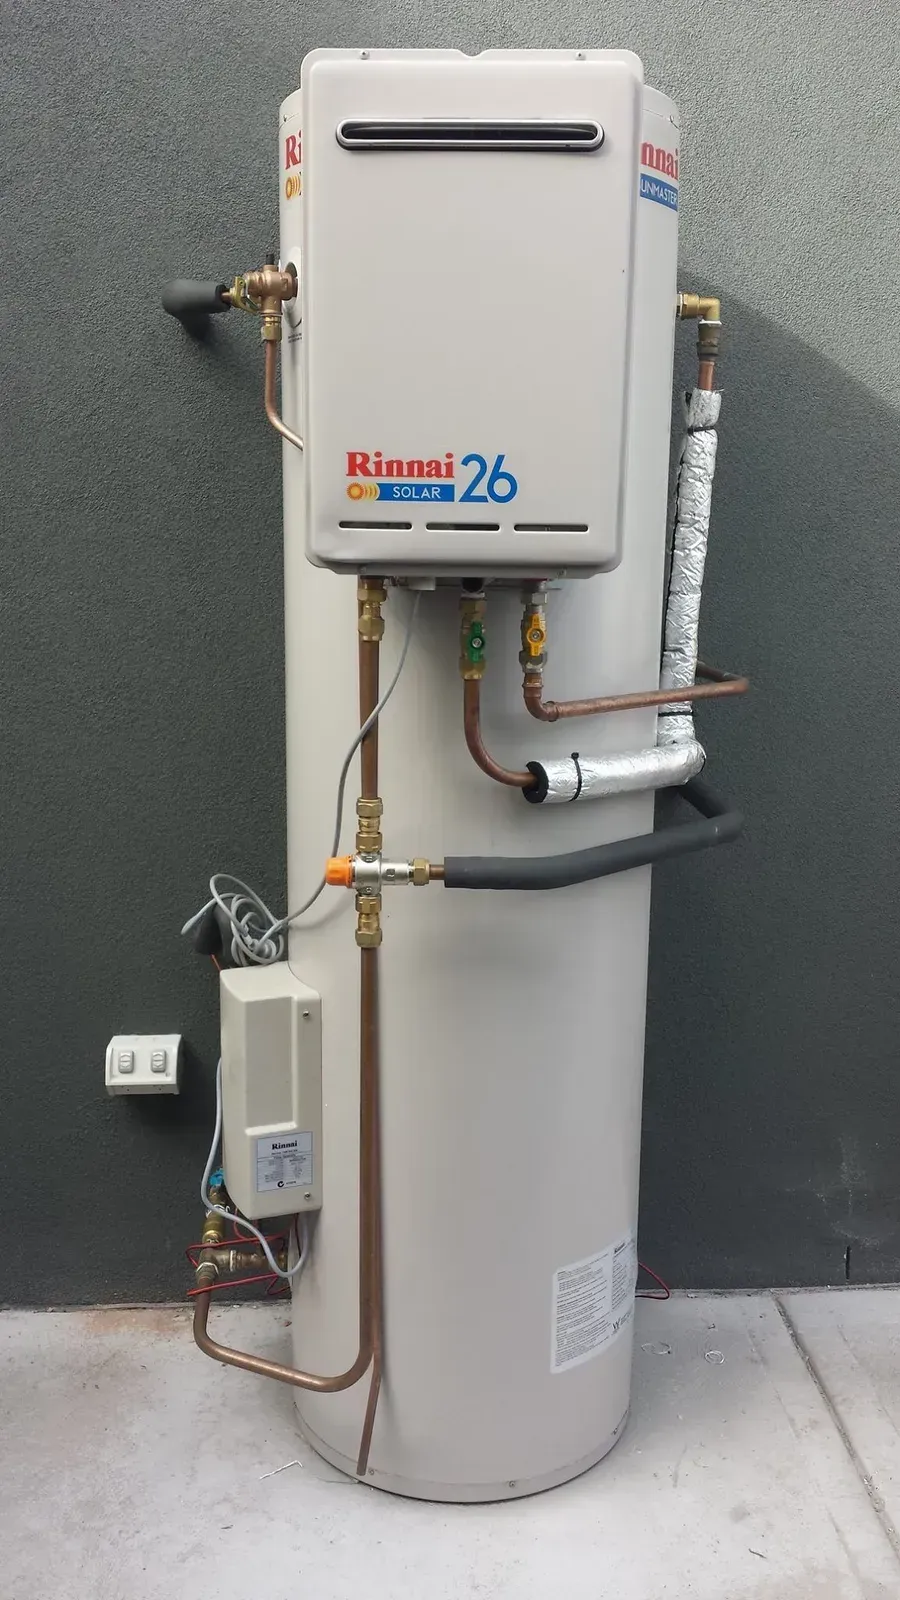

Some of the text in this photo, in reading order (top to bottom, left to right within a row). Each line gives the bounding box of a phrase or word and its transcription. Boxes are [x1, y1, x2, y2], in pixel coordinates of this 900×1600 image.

[346, 451, 455, 478] Rinnai
[458, 453, 518, 504] 26
[392, 486, 441, 499] SOLAR
[271, 1140, 298, 1150] Rinnai
